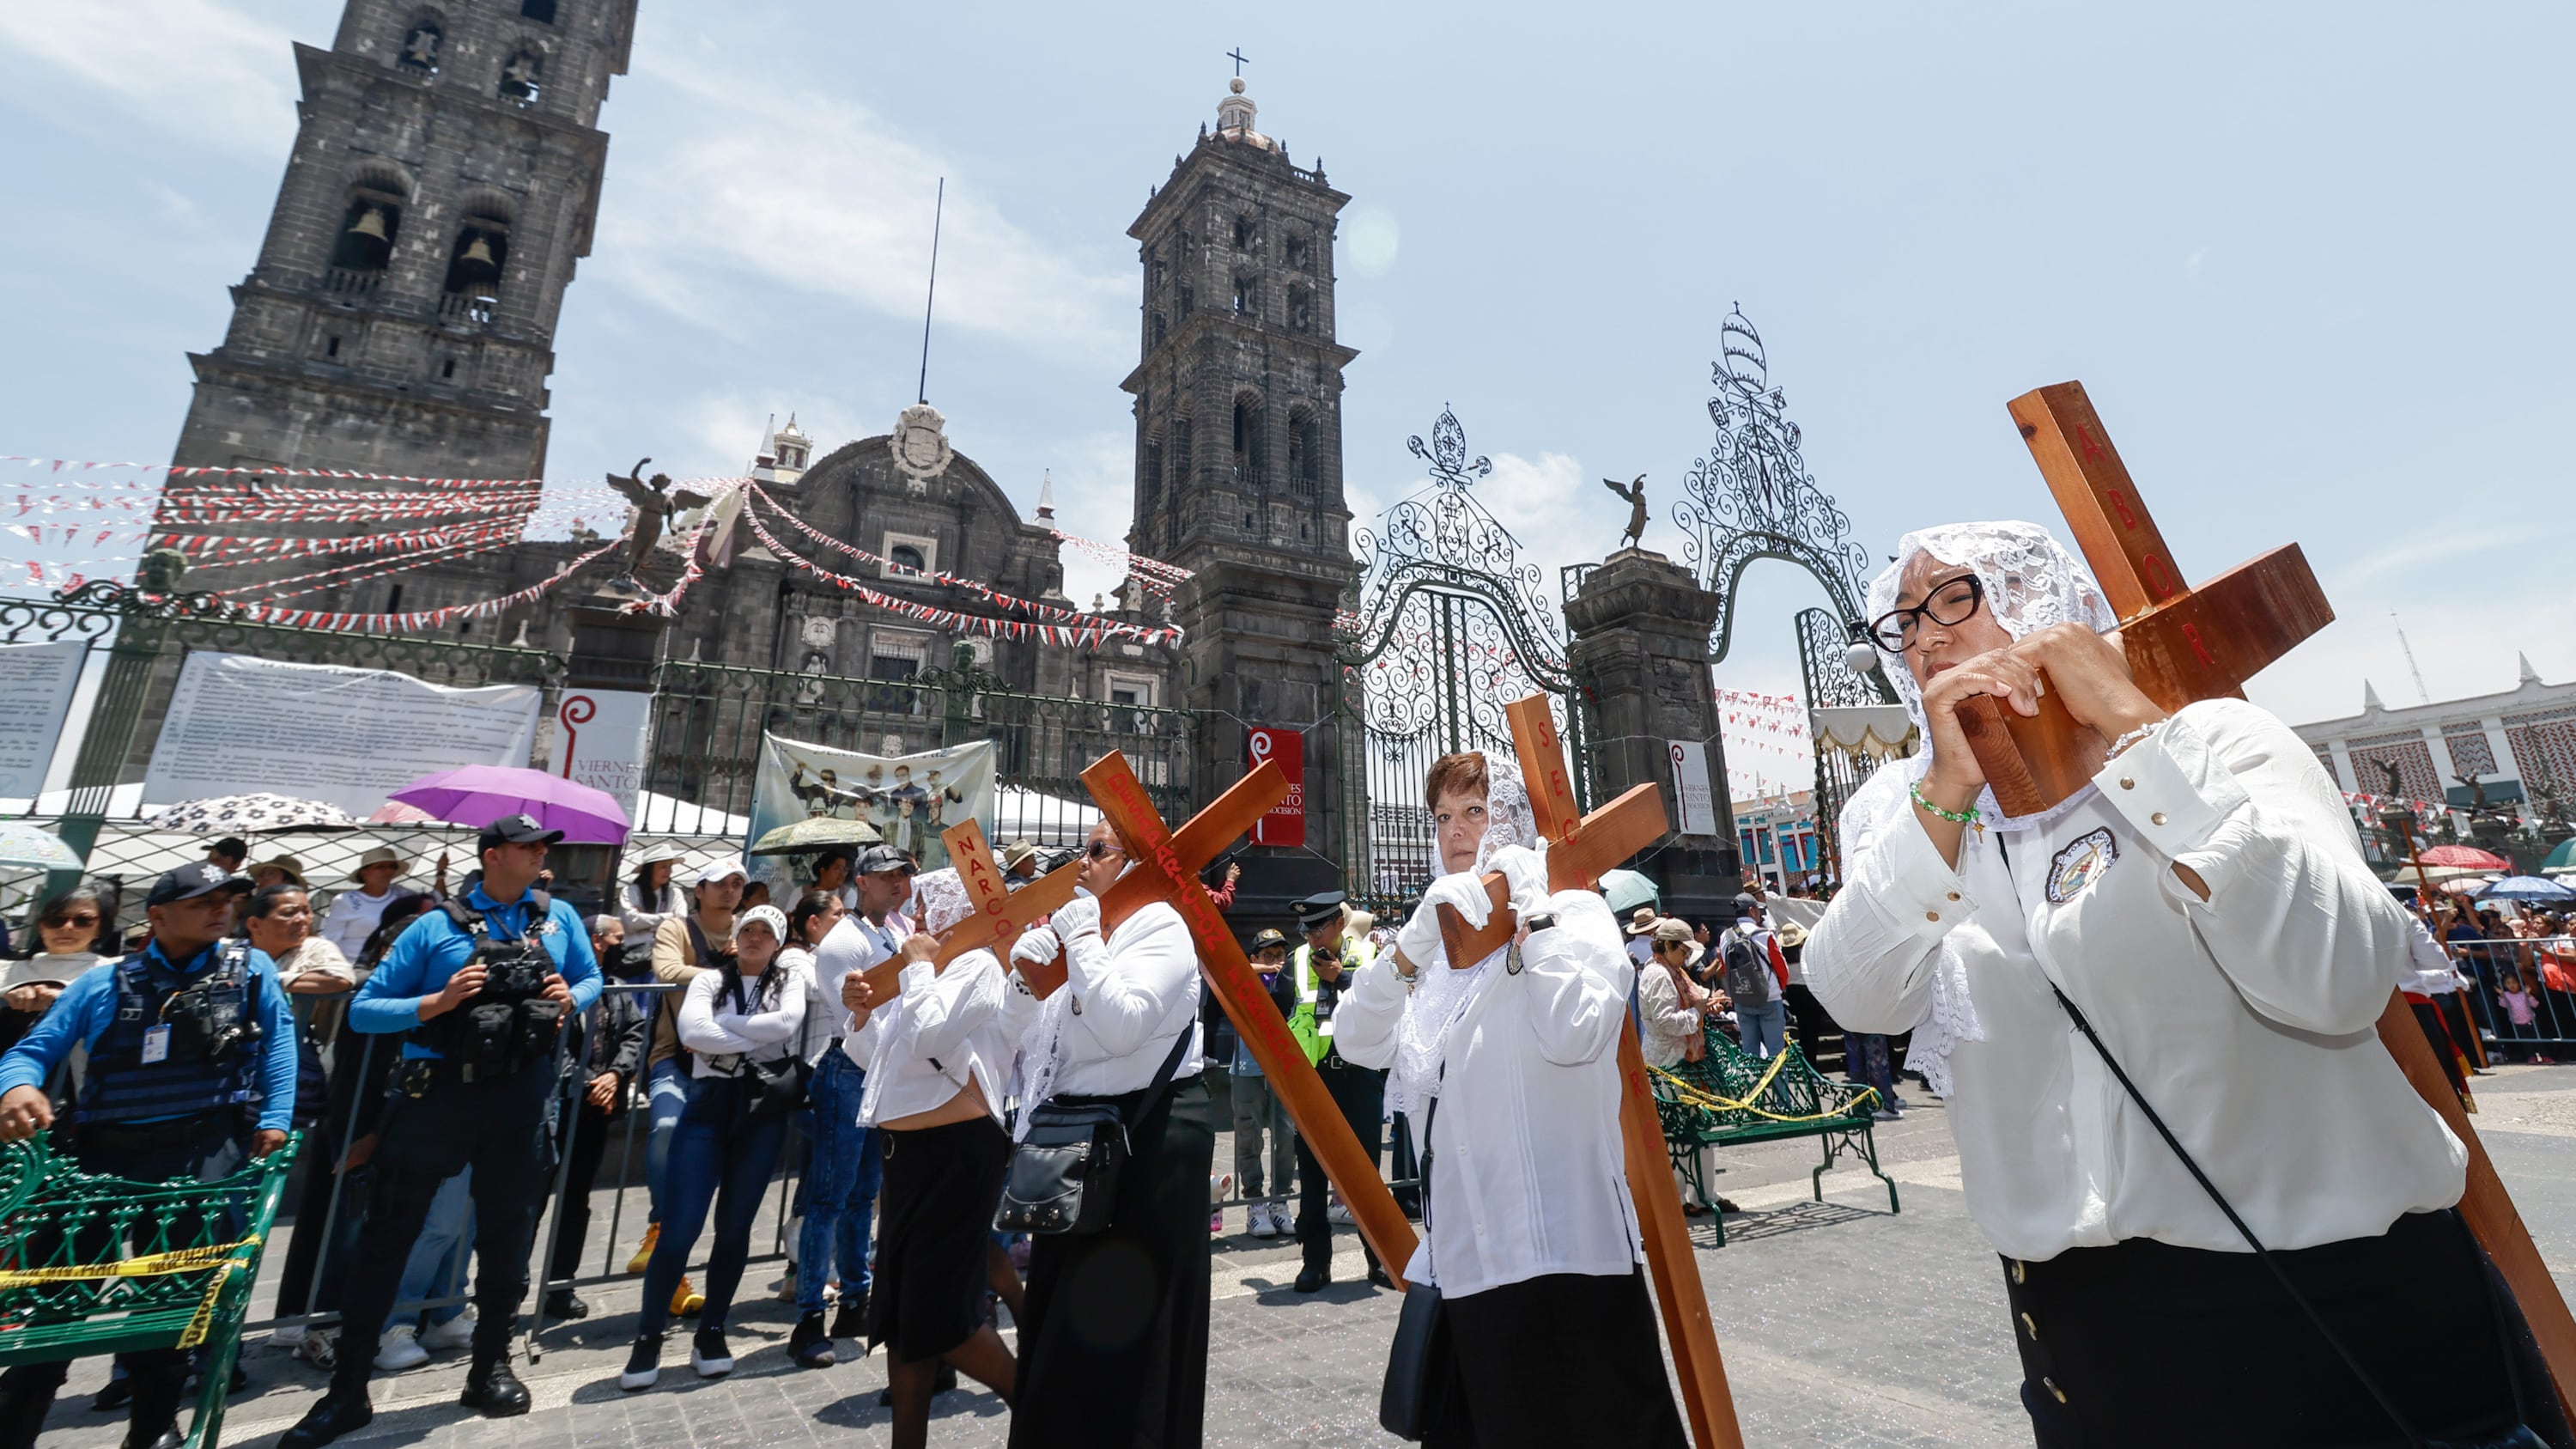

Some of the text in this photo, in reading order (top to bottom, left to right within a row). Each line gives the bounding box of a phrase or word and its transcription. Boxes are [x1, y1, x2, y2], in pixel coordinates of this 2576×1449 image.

[2076, 422, 2228, 697] ABOR
[578, 759, 640, 774] VIERNES
[574, 774, 639, 790] SANTO
[1686, 793, 1710, 802] SANTO
